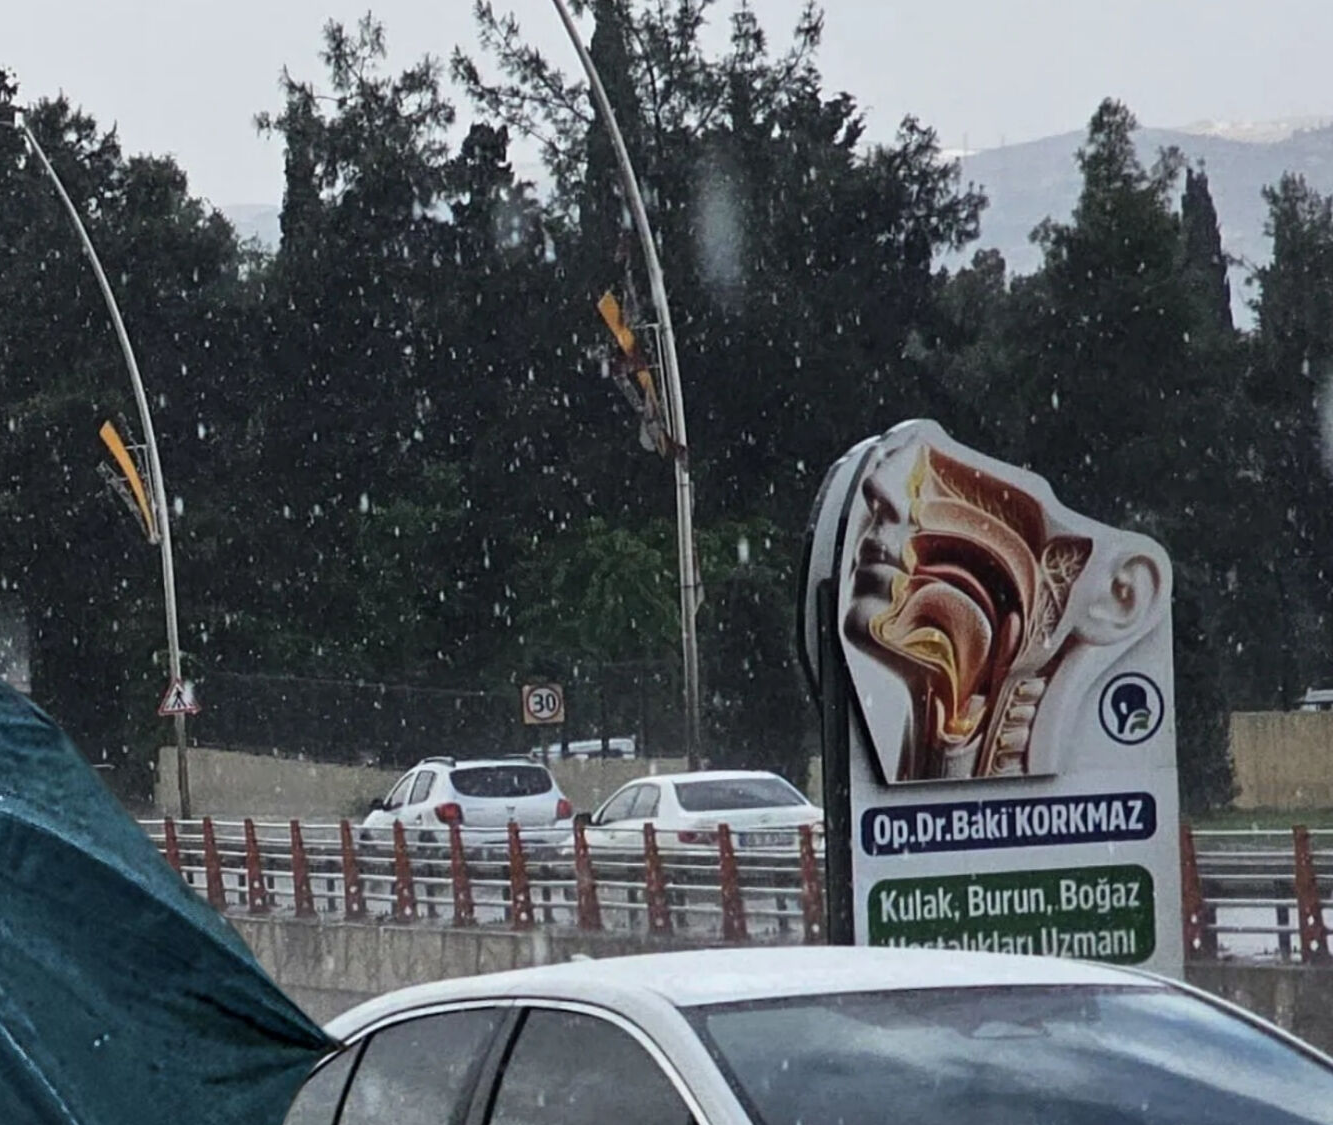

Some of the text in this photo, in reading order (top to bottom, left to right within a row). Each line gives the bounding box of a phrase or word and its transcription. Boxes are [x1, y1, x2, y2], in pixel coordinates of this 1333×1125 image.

[533, 693, 556, 713] 30
[1015, 800, 1143, 837] KORKMAZ
[967, 885, 1052, 917] Burun,
[1059, 877, 1140, 914] Boğaz
[1040, 928, 1136, 958] Uzmanı
